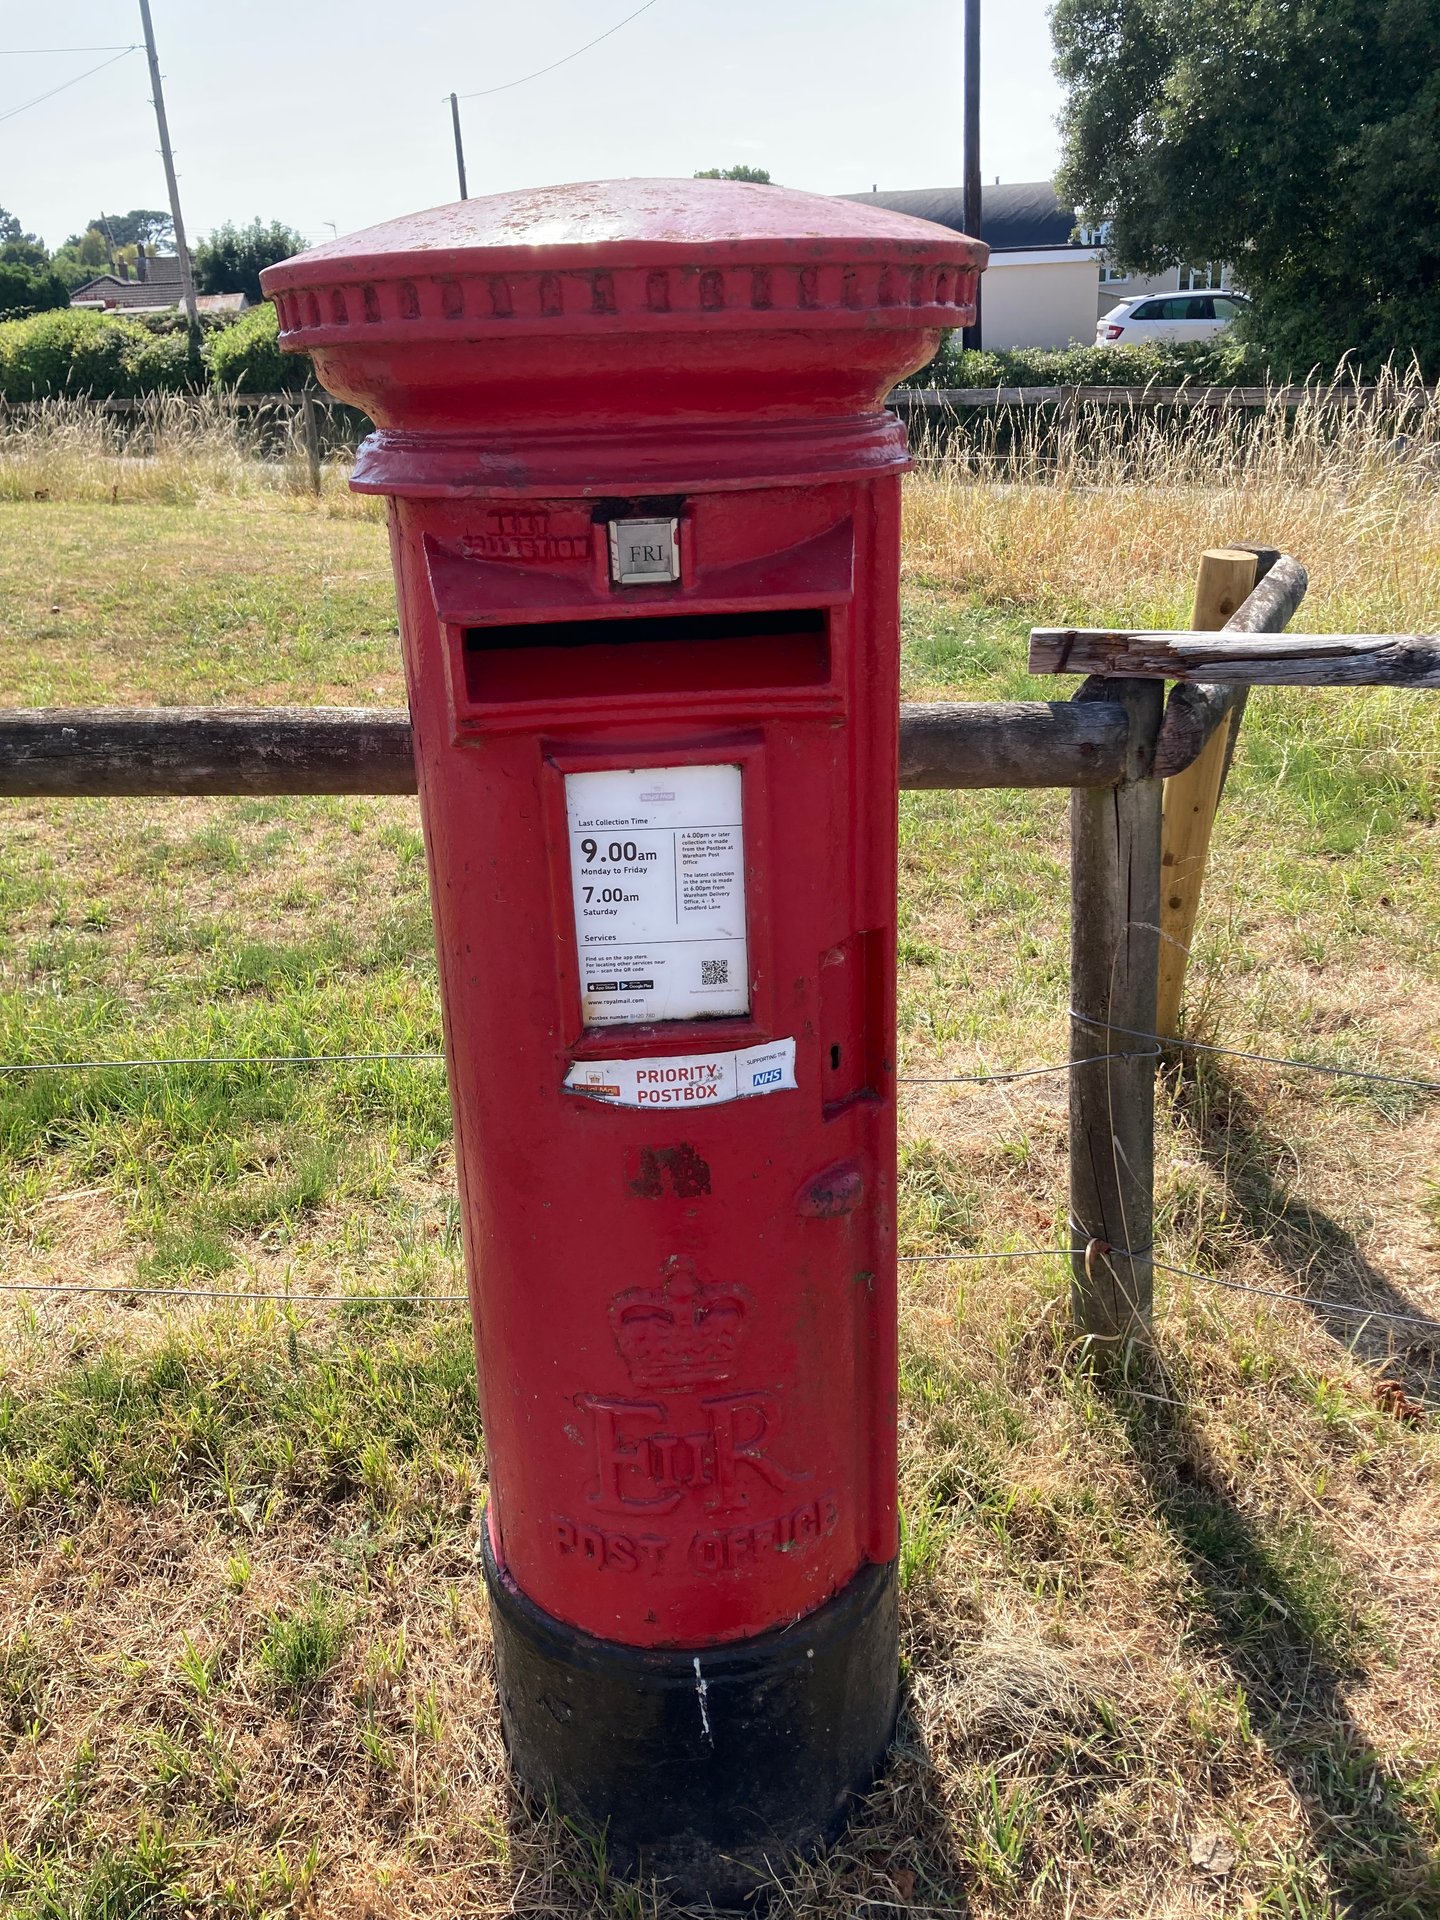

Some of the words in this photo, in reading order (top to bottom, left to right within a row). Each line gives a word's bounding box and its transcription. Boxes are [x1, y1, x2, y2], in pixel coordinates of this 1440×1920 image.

[629, 545, 663, 562] FRI
[595, 818, 629, 826] Collection
[631, 817, 649, 825] Time
[580, 838, 657, 863] 9.00am
[581, 868, 611, 876] Monday
[624, 866, 648, 875] Friday
[582, 886, 640, 904] 7.00am
[583, 908, 618, 919] Saturday
[584, 934, 617, 942] Services
[588, 997, 645, 1006] www.royalmail.com
[746, 1053, 776, 1066] SUPPORTING
[777, 1050, 787, 1059] THE
[636, 1064, 717, 1083] PRIORITY
[754, 1070, 781, 1086] NHS
[637, 1084, 718, 1103] POSTBOX
[551, 1510, 669, 1574] POST
